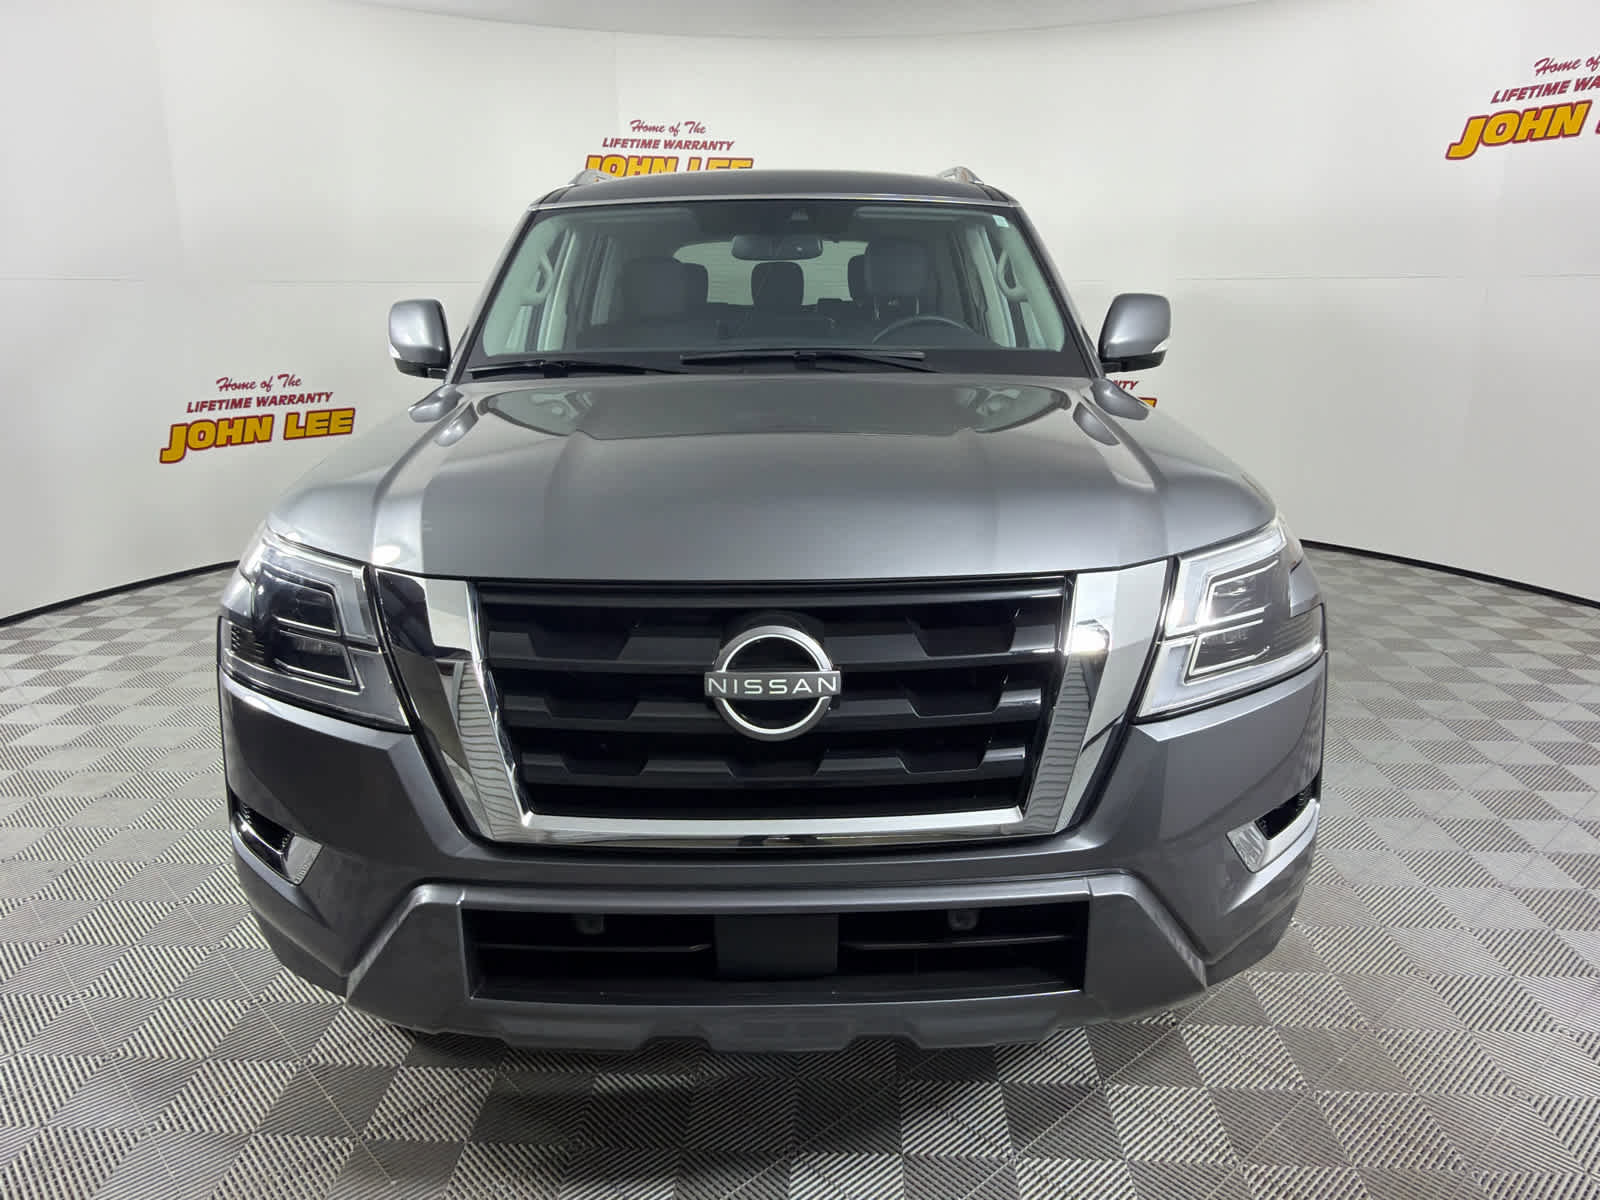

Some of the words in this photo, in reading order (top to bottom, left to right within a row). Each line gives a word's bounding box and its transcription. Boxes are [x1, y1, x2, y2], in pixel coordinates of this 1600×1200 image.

[1534, 57, 1581, 76] Home
[1490, 80, 1571, 104] LIFETIME
[630, 120, 665, 133] Home
[669, 122, 680, 136] of
[684, 121, 706, 134] The
[1445, 99, 1592, 160] JOHN
[602, 138, 660, 149] LIFETIME
[663, 139, 734, 151] WARRANTY
[216, 376, 257, 392] Home
[260, 376, 273, 392] of
[277, 374, 301, 388] The
[187, 397, 252, 413] LIFETIME
[256, 391, 333, 408] WARRANTY
[160, 414, 275, 464] JOHN
[283, 407, 355, 440] LEE
[708, 676, 837, 694] NISSAN
